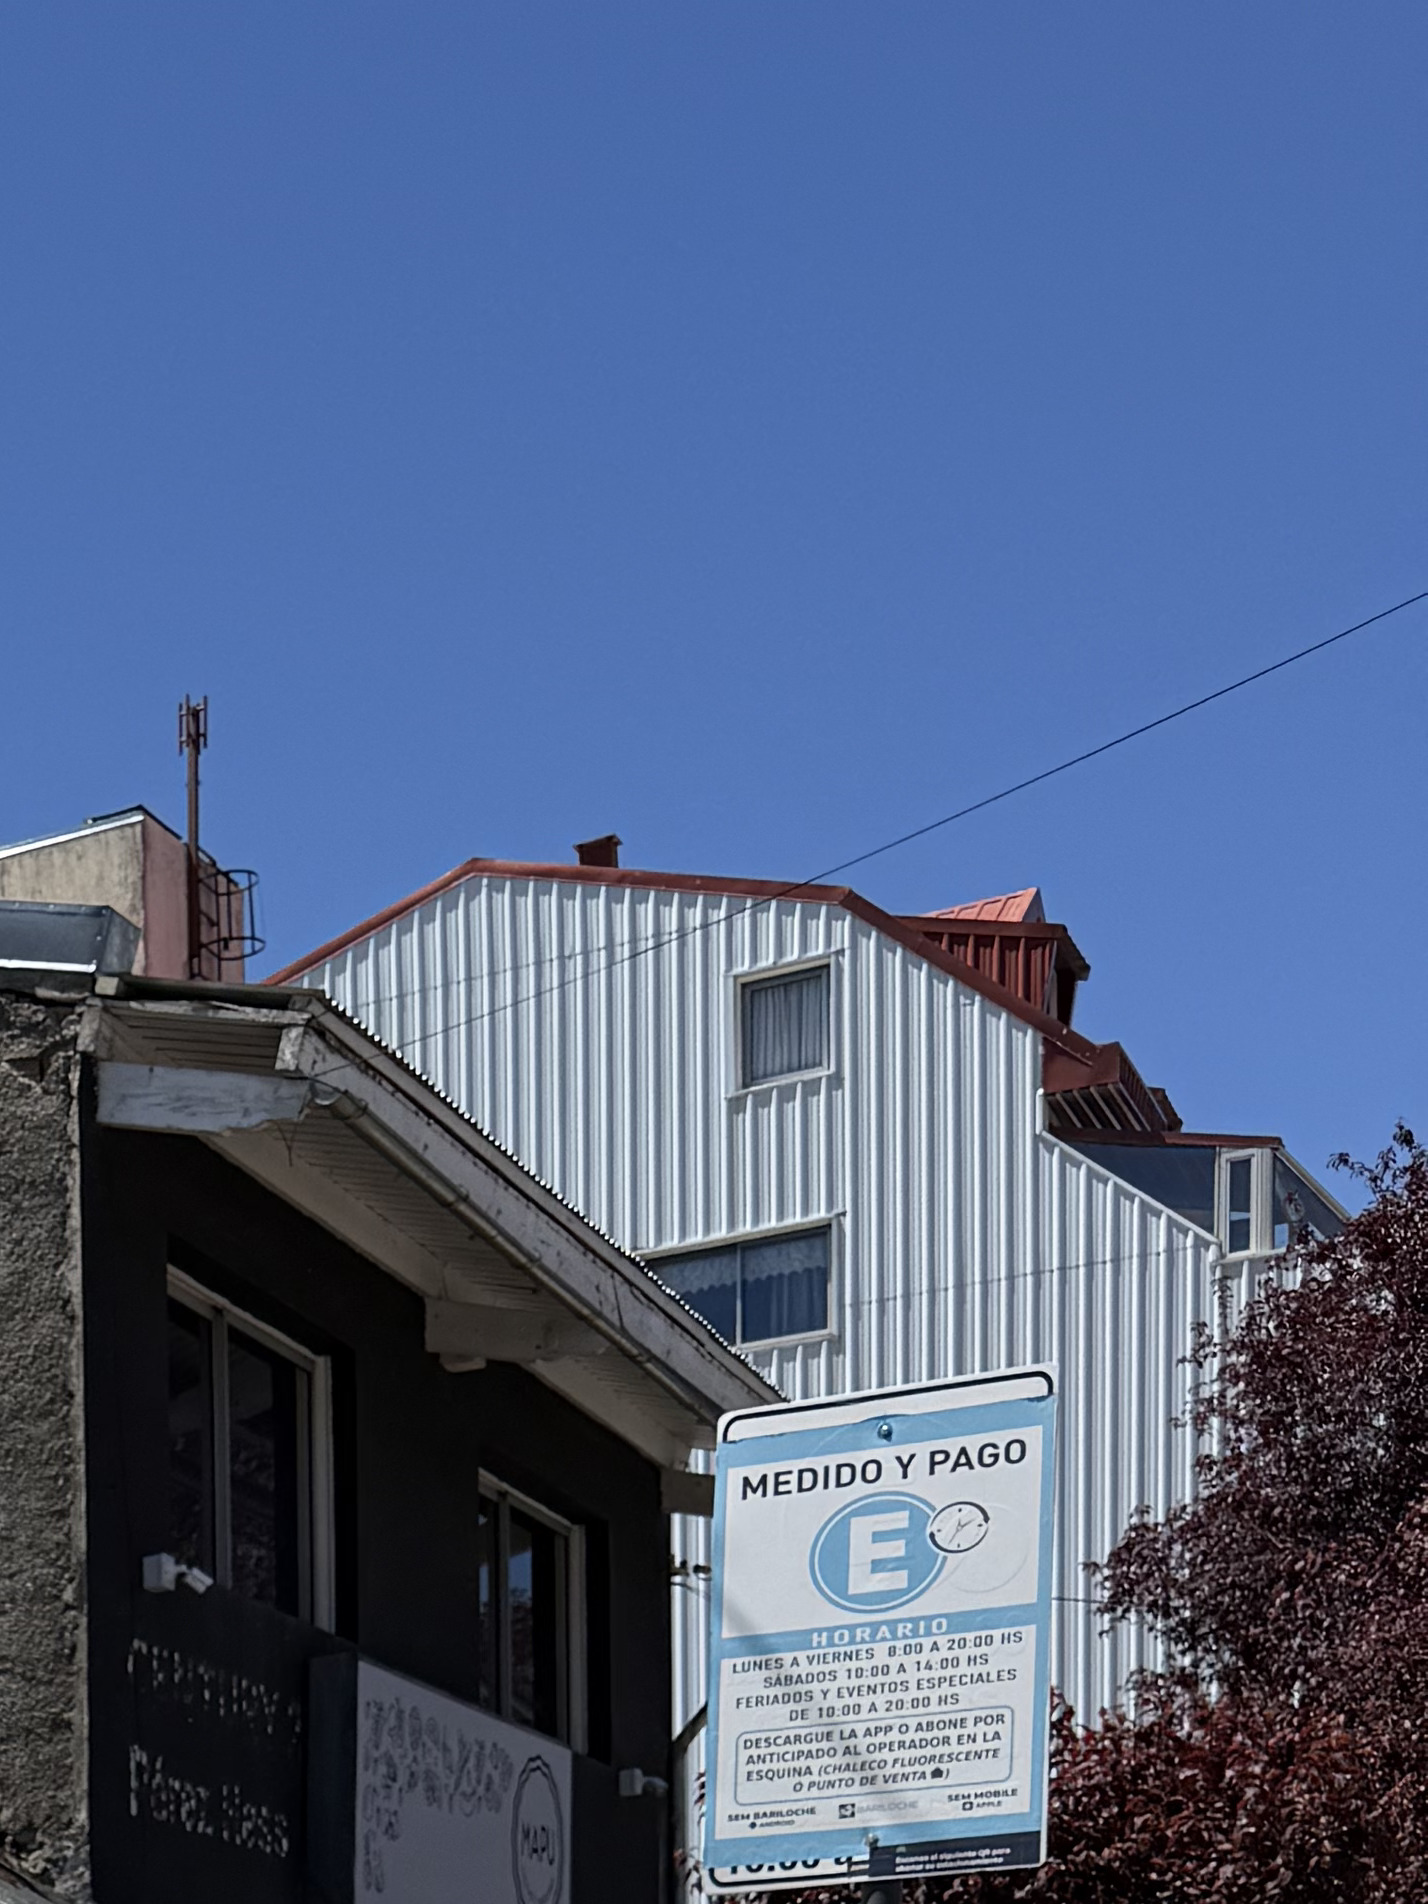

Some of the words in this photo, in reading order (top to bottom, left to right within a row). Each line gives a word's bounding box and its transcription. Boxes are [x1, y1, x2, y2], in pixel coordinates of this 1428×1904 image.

[740, 1459, 883, 1500] MEDIDO
[895, 1454, 917, 1480] Y
[929, 1439, 1027, 1476] PAGO
[848, 1510, 909, 1595] E
[812, 1618, 948, 1648] HORARIO
[733, 1658, 784, 1674] LUNES
[790, 1656, 800, 1668] A
[807, 1648, 875, 1666] VIERNES
[930, 1640, 940, 1652] A
[947, 1635, 993, 1651] 20:00
[1001, 1631, 1023, 1645] HS
[736, 1691, 813, 1709] FERIADOS
[820, 1688, 830, 1701] Y
[837, 1681, 909, 1700] EVENTOS
[916, 1669, 1017, 1690] ESPECIALES
[763, 1669, 837, 1689] SÁBADOS
[846, 1664, 890, 1680] 10:00
[897, 1662, 907, 1674] A
[915, 1657, 959, 1672] 14:00
[967, 1654, 989, 1667] HS
[789, 1708, 809, 1722] DE
[817, 1703, 861, 1719] 10:00
[868, 1701, 878, 1713] A
[885, 1696, 930, 1712] 20:00
[938, 1693, 959, 1707] HS
[743, 1731, 834, 1750] DESCARGUE
[839, 1728, 857, 1741] LA
[864, 1725, 893, 1738] APP
[898, 1723, 909, 1735] O
[915, 1717, 967, 1734] ABONE
[973, 1713, 1006, 1726] POR
[745, 1747, 837, 1766] ANTICIPADO
[842, 1745, 861, 1757] AL
[866, 1736, 950, 1755] OPERADOR
[957, 1733, 977, 1744] EN
[983, 1731, 1001, 1743] LA
[746, 1766, 813, 1783] ESQUINA
[818, 1759, 887, 1776] (CHALECO
[892, 1748, 1000, 1768] FLUORESCENTE
[793, 1782, 803, 1793] O
[807, 1777, 855, 1792] PUNTO
[860, 1775, 877, 1787] DE
[882, 1771, 927, 1786] VENTA
[947, 1793, 971, 1803] SEM
[974, 1788, 1018, 1800] MOBILE
[727, 1813, 750, 1822] SEM
[753, 1806, 816, 1820] BARILOCHE
[520, 1822, 556, 1866] MAPU
